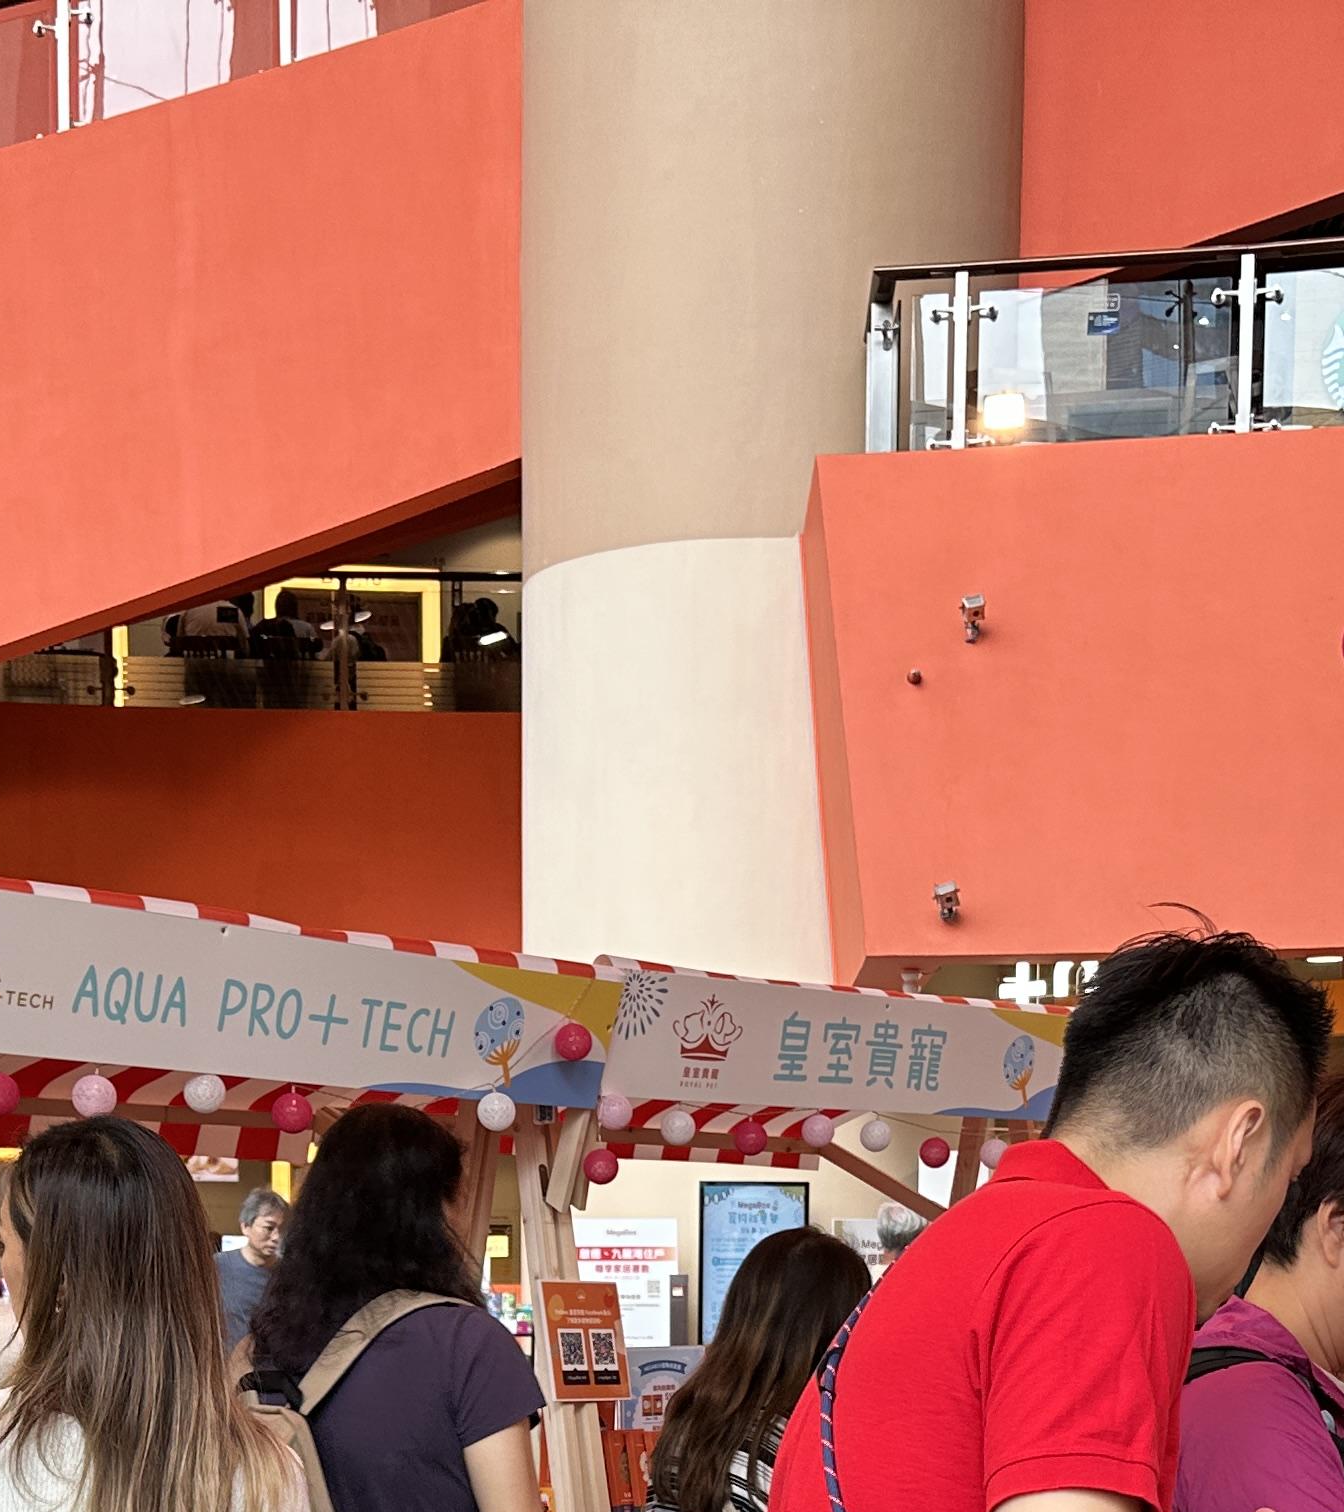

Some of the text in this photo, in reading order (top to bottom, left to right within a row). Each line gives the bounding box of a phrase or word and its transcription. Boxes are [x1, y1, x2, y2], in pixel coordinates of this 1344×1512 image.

[72, 965, 454, 1058] AQUA PRO+TECH
[773, 1011, 948, 1092] 皇室貴寵
